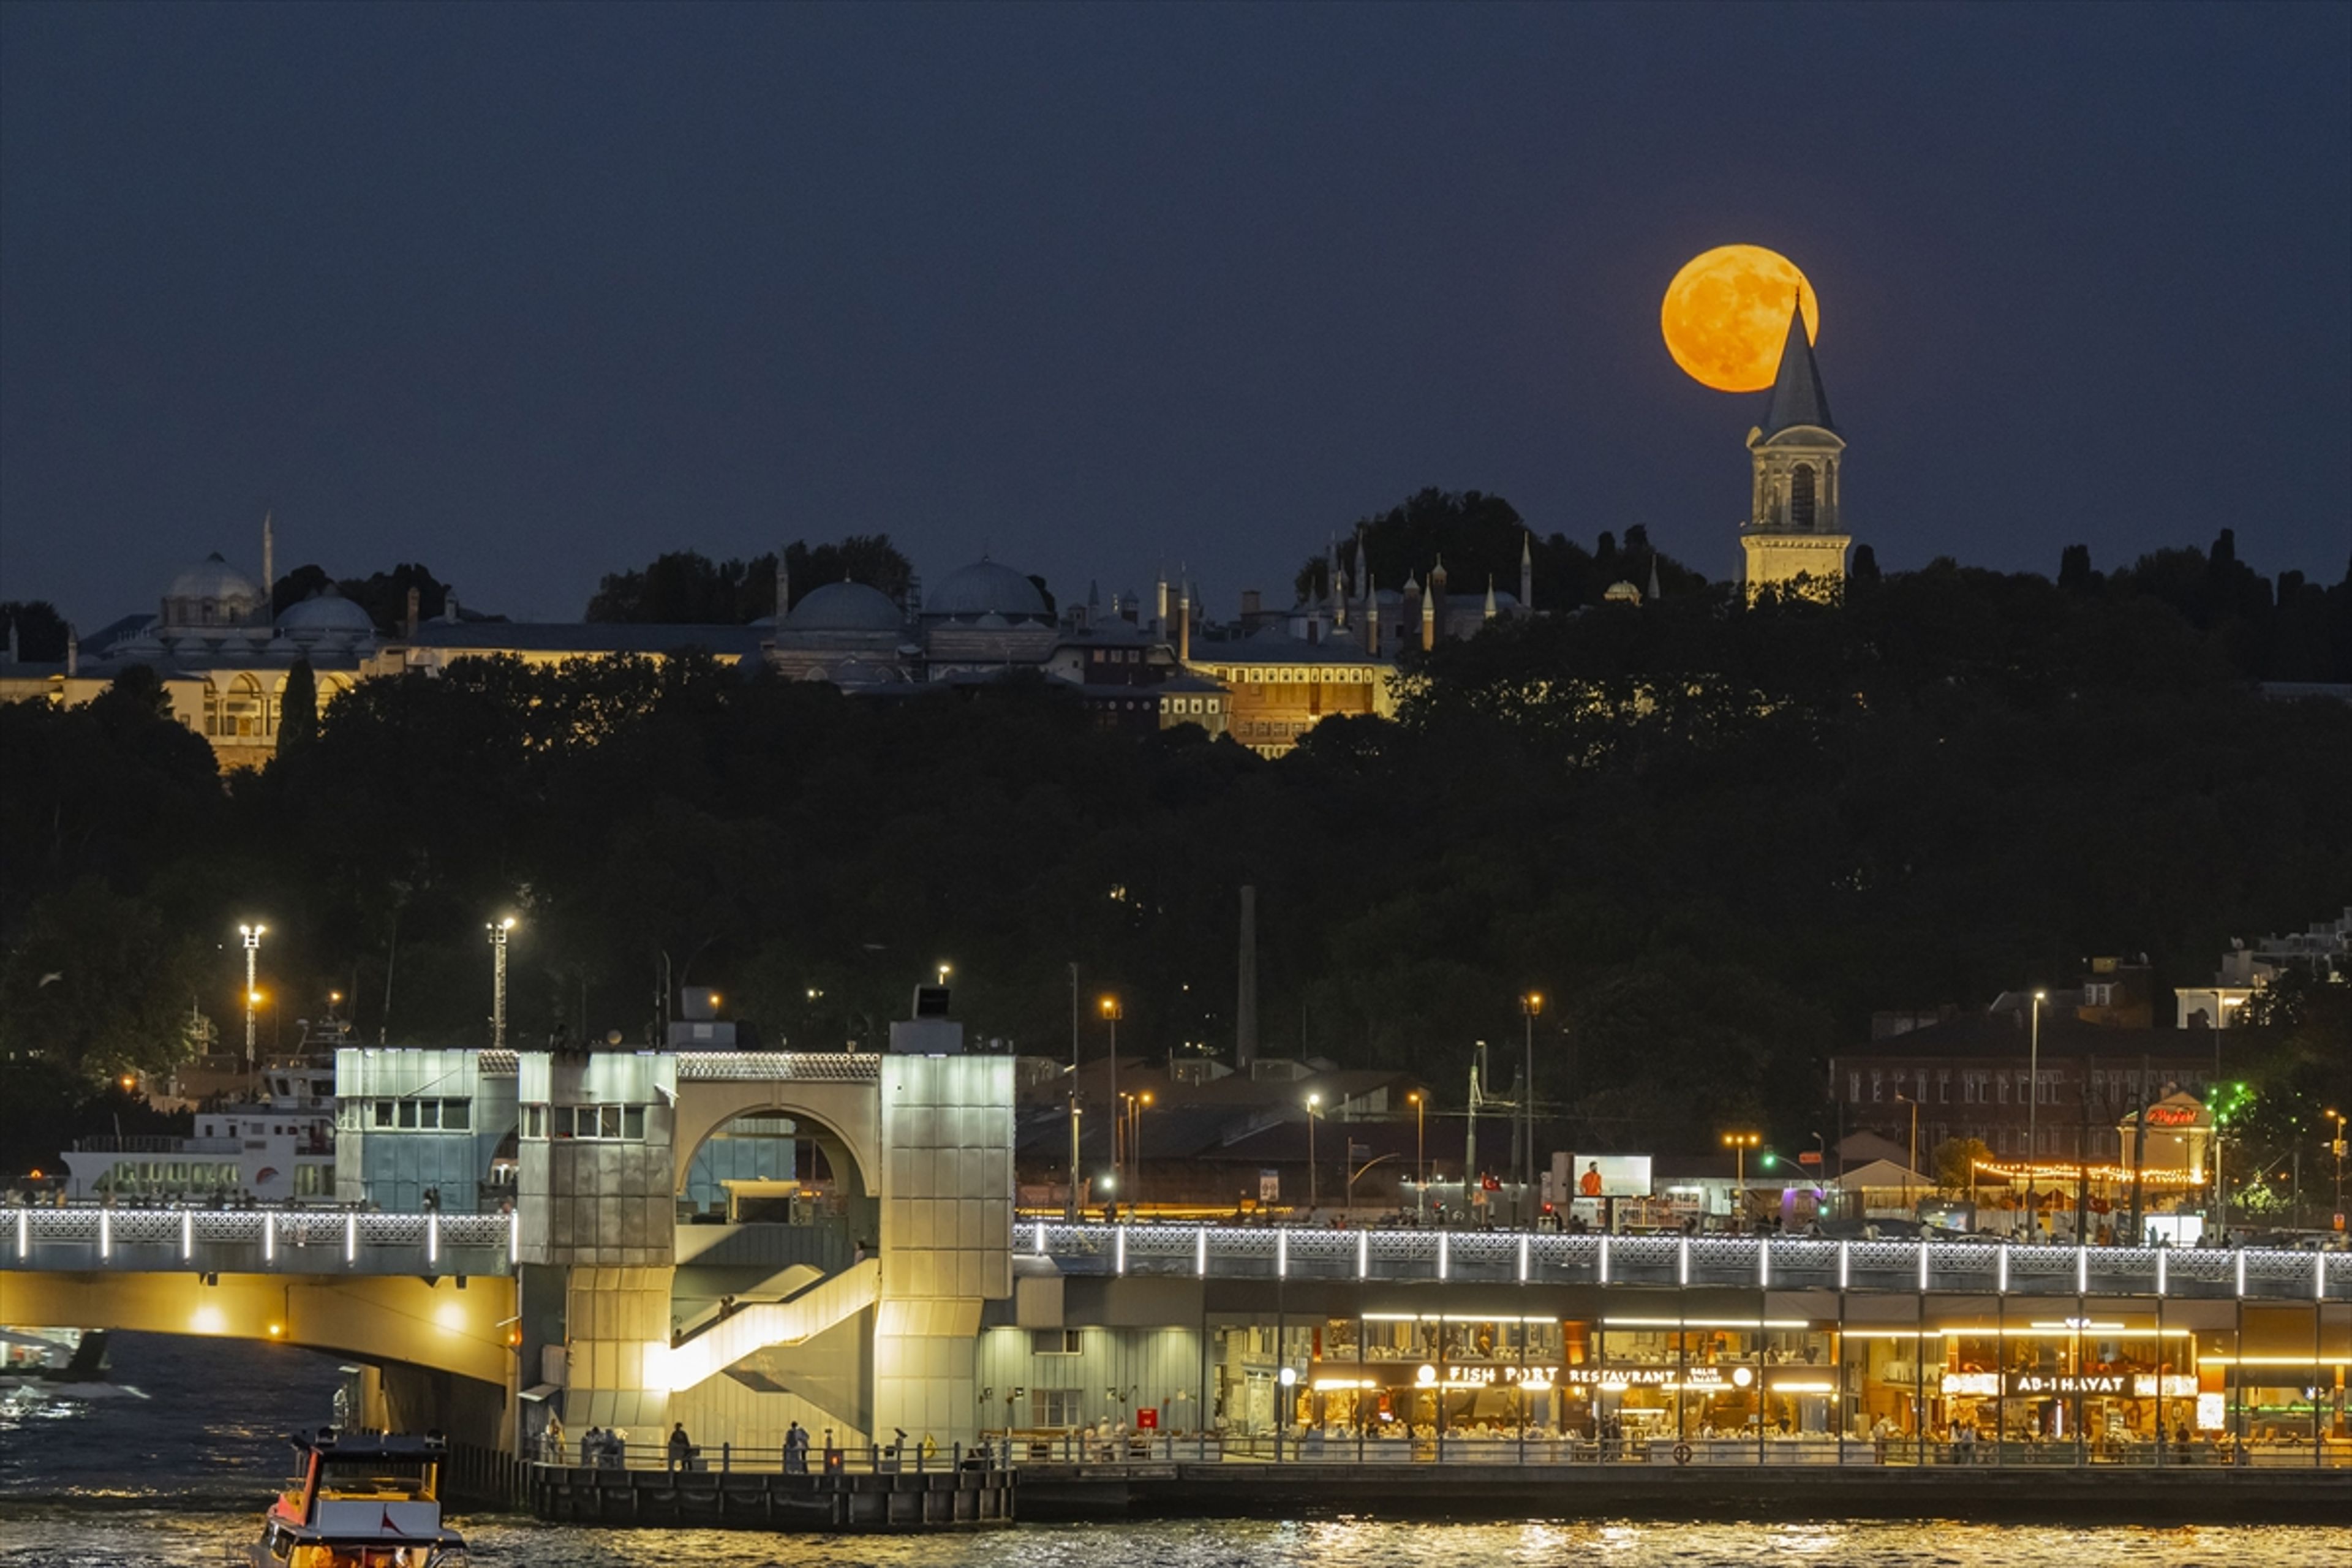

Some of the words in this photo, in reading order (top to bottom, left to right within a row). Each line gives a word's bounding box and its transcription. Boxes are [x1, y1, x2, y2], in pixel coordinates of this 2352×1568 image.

[1449, 1366, 1496, 1382] FISH
[1504, 1366, 1559, 1382] PORT
[1569, 1370, 1676, 1383] RESTAURANT
[2060, 1377, 2124, 1392] HAYAT
